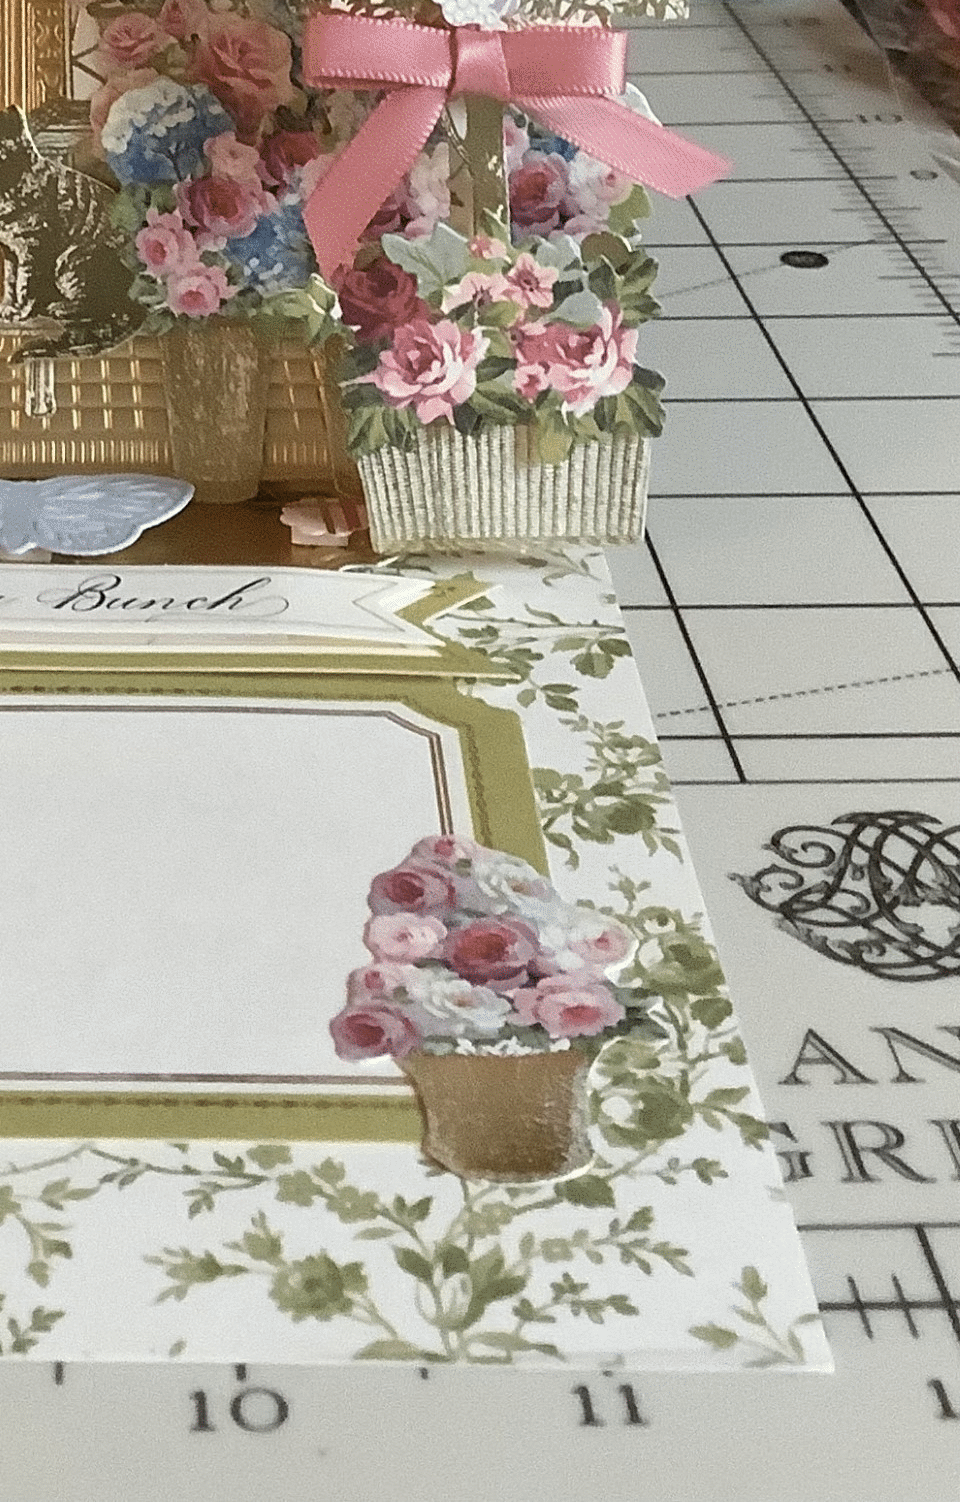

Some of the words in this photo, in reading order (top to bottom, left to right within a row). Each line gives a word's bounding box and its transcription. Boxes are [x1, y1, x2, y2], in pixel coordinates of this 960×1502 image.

[36, 573, 290, 622] Bunch
[189, 1387, 289, 1432] 10
[571, 1383, 649, 1426] 11
